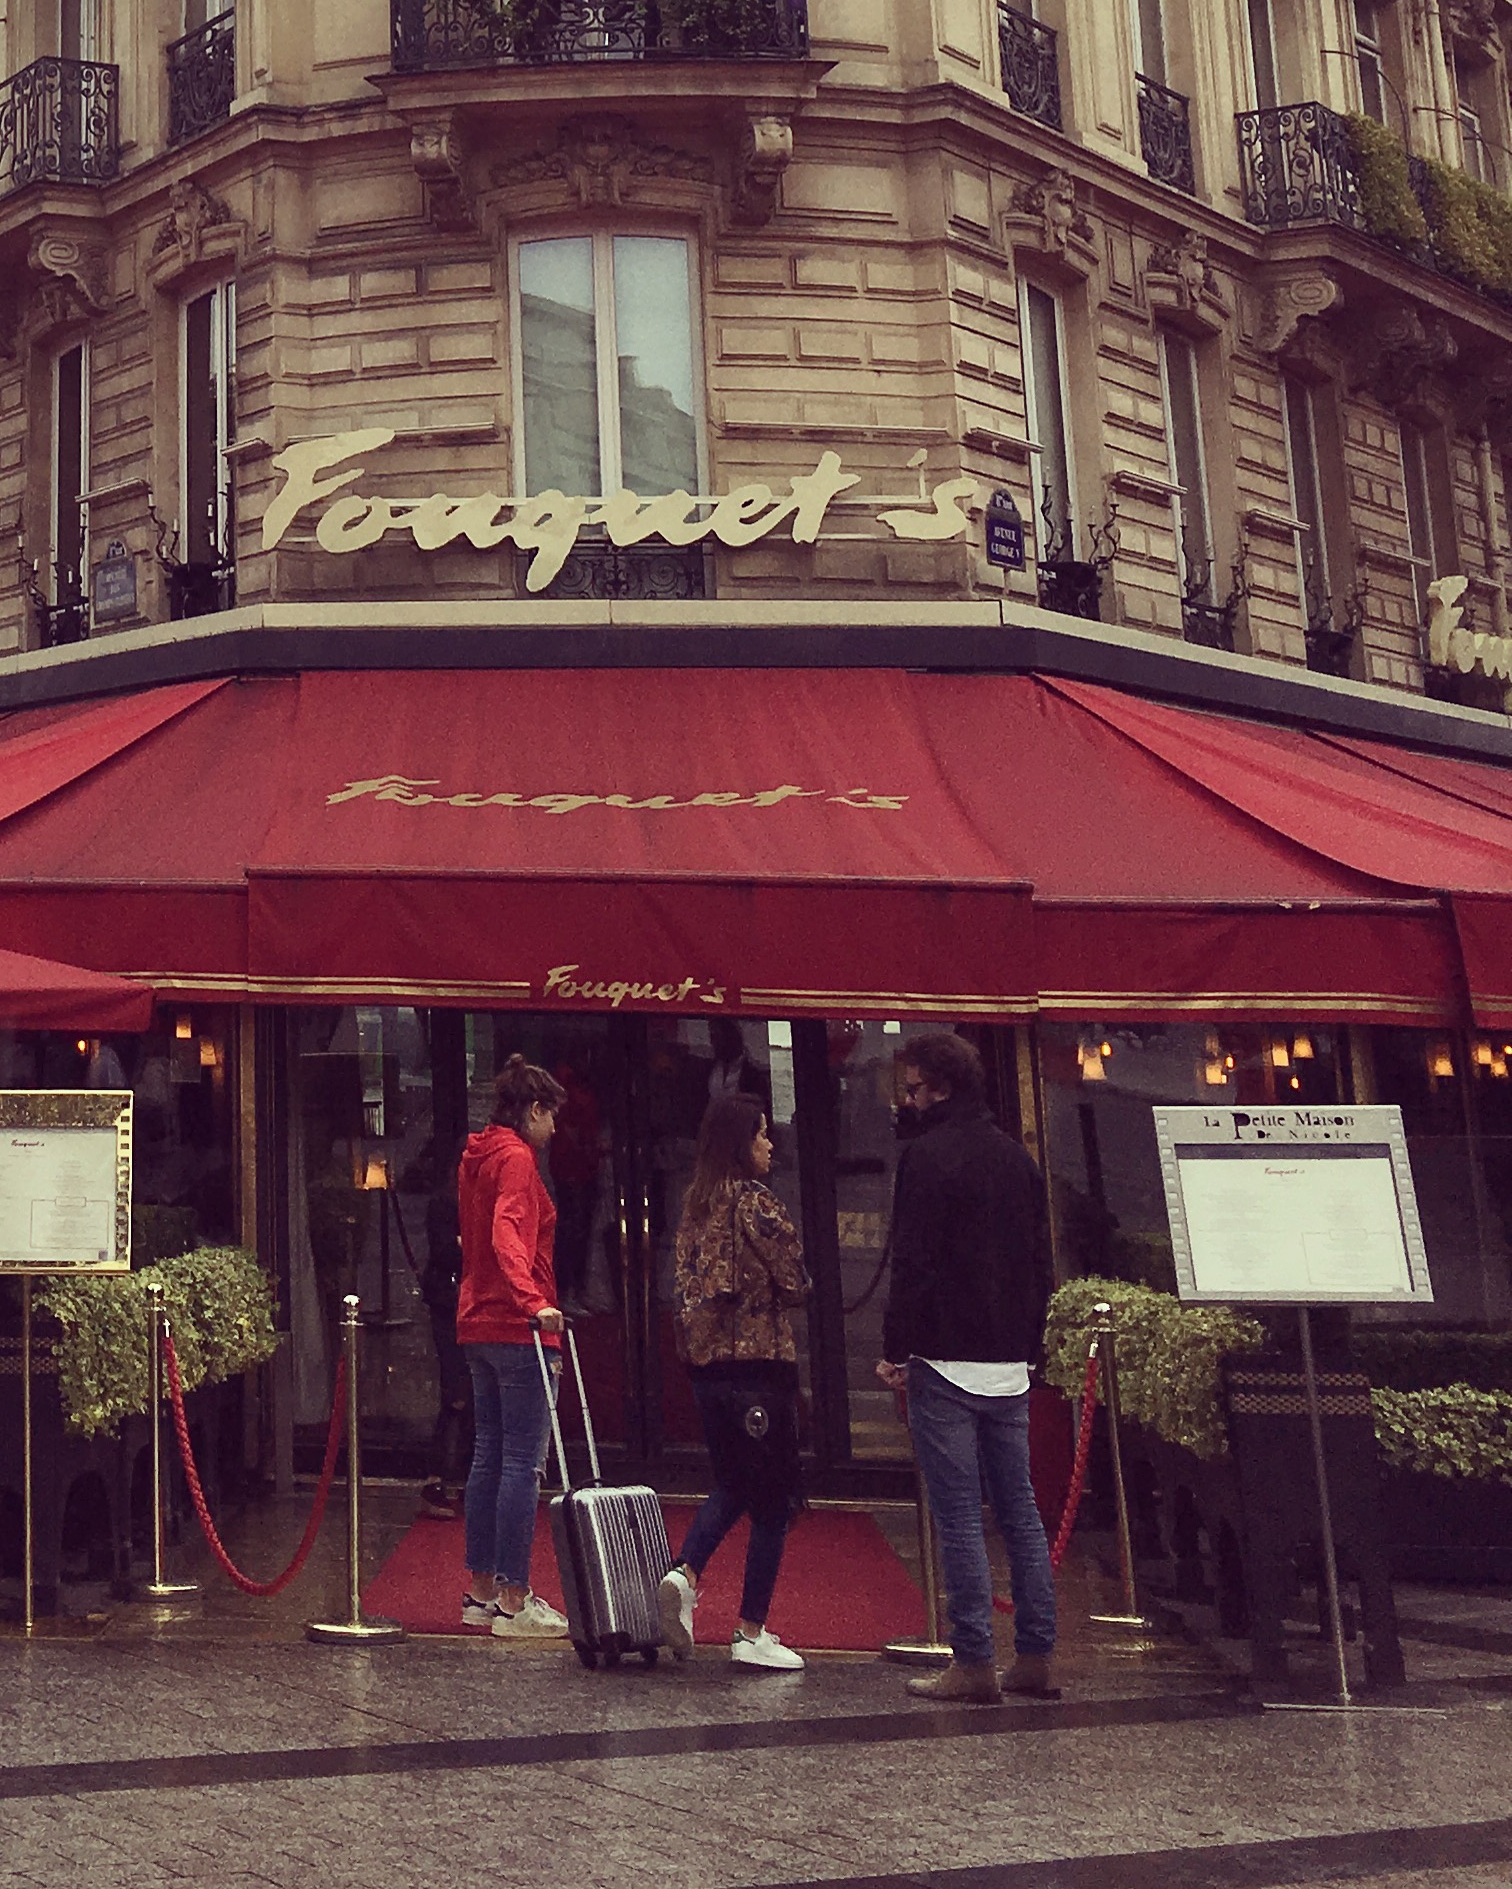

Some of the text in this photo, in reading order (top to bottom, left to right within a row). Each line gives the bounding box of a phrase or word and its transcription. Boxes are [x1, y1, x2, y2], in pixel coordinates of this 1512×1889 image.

[262, 428, 980, 592] Fouquet's
[325, 773, 910, 814] Fouquet's
[542, 964, 728, 1007] Fouquet's
[1230, 1112, 1287, 1140] Petite
[1294, 1111, 1355, 1127] Maison
